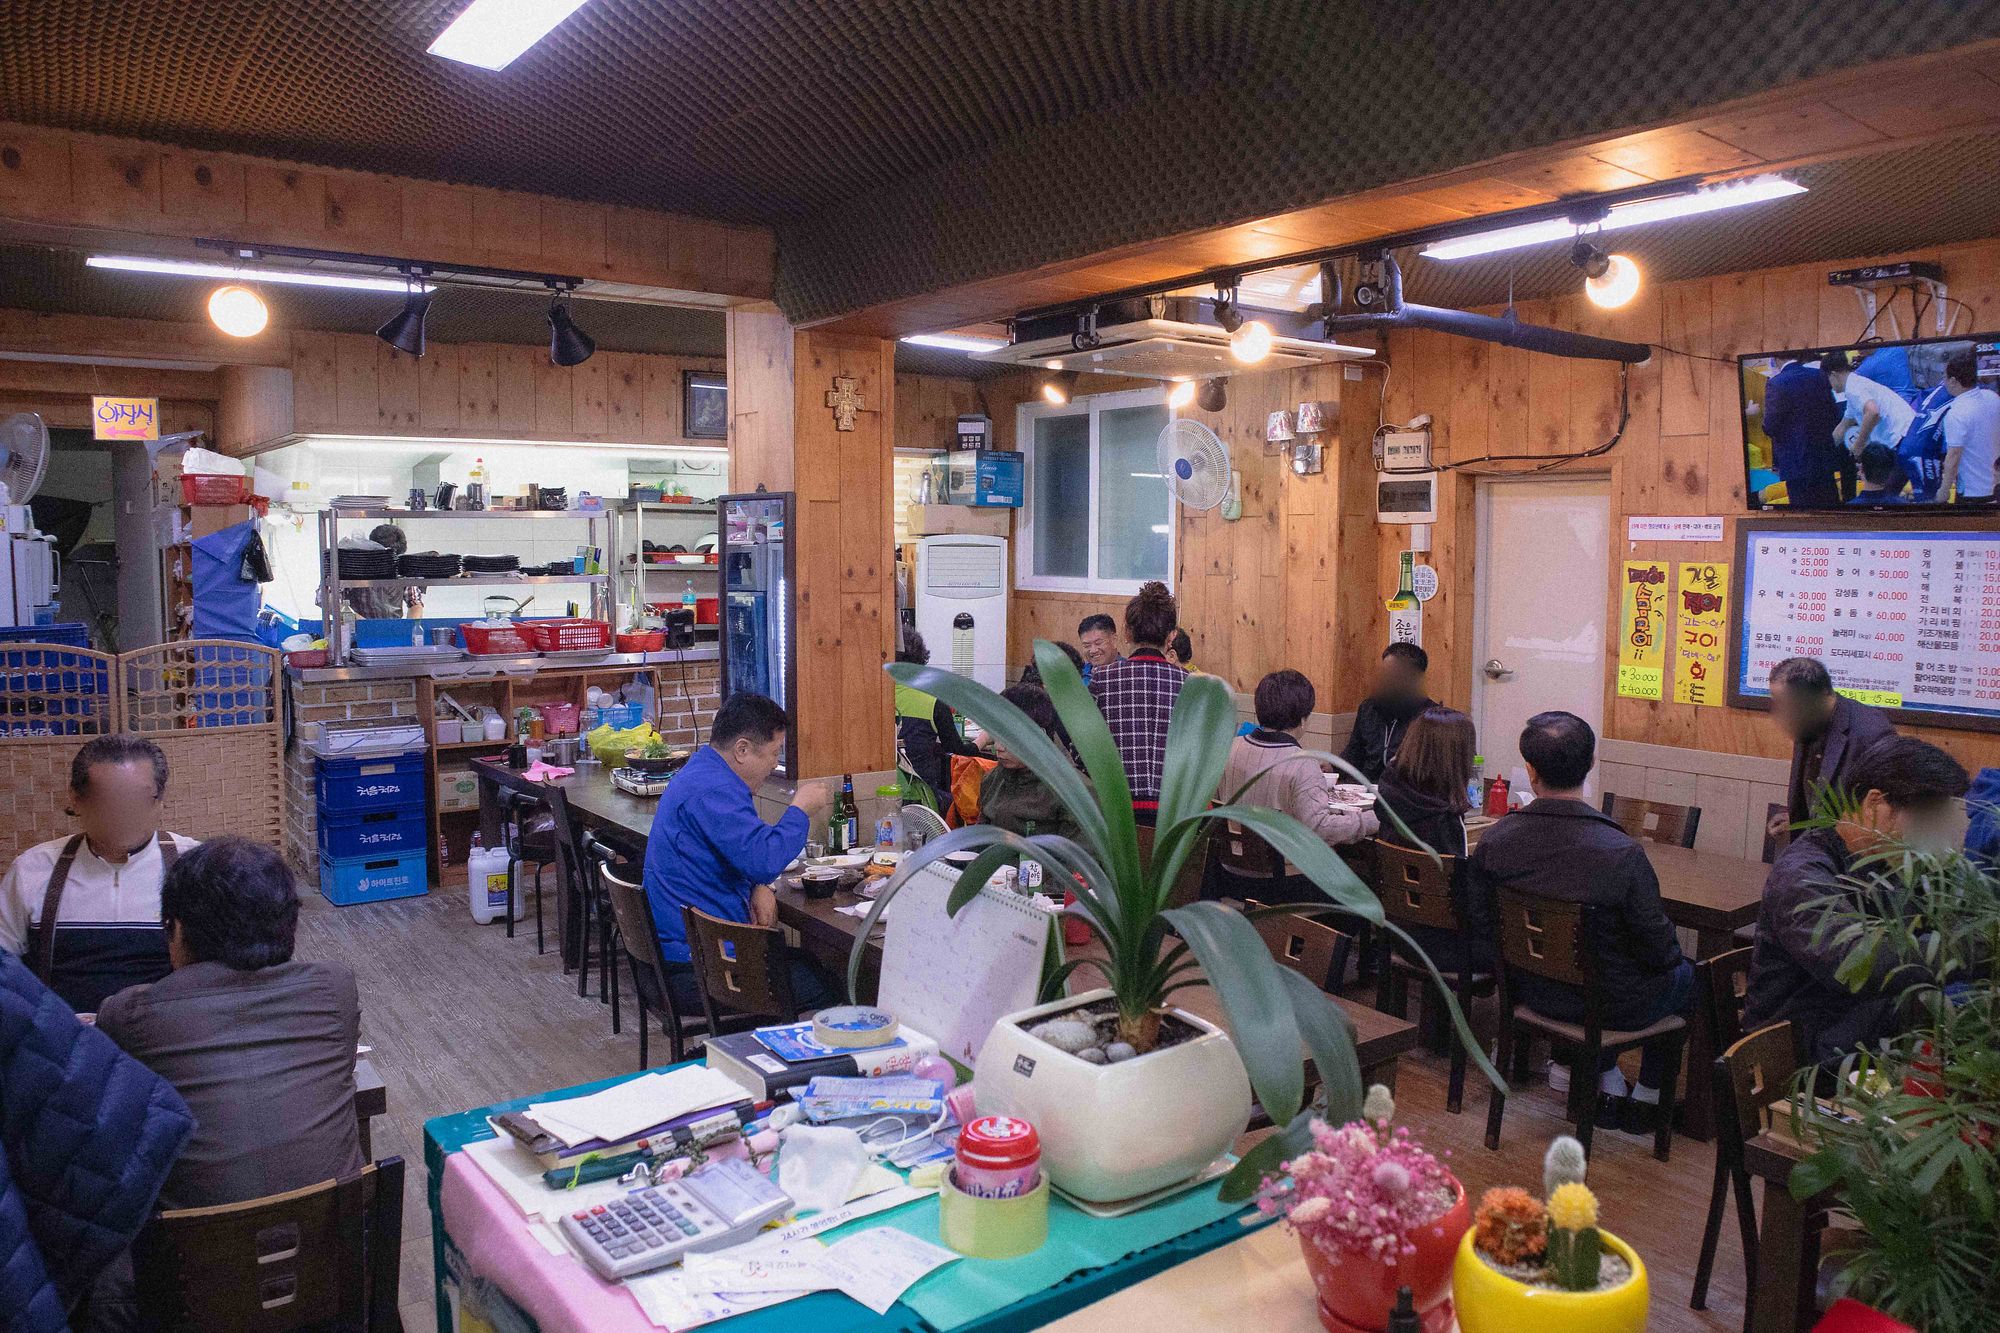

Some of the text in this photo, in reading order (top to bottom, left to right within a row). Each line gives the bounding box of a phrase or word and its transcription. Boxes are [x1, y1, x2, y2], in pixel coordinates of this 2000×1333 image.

[1975, 343, 1994, 353] SBS
[98, 401, 152, 426] 화장실
[1395, 618, 1412, 637] 좋은
[1684, 630, 1717, 647] 구이
[1690, 660, 1707, 681] 회
[356, 784, 401, 797] 처음처럼
[359, 833, 402, 844] 처음처럼
[370, 875, 409, 888] 하이트진로
